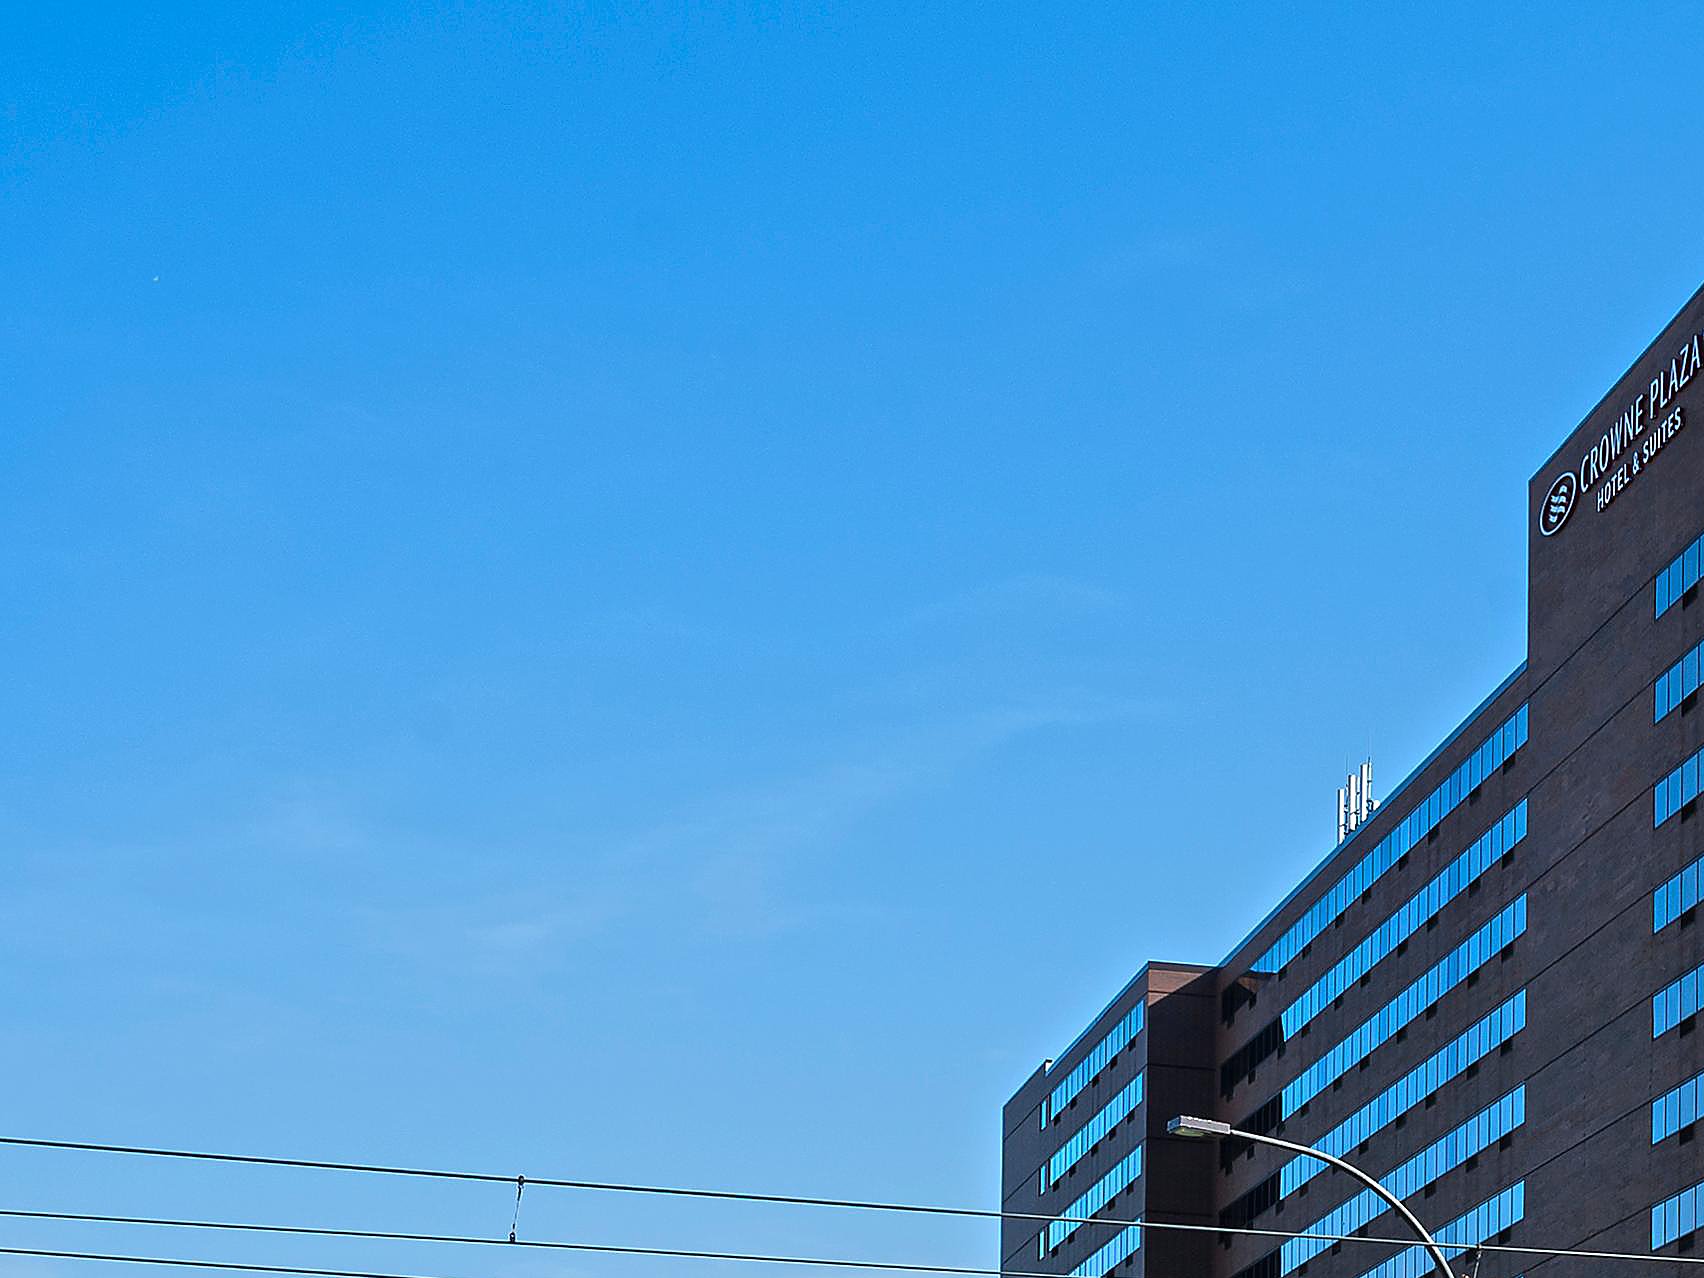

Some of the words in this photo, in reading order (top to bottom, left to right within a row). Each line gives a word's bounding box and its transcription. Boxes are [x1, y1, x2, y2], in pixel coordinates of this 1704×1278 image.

[1580, 394, 1644, 493] CROWNE
[1650, 334, 1701, 419] PLAZA
[1597, 463, 1630, 513] HOTEL
[1632, 452, 1640, 474] &
[1643, 407, 1682, 464] SUITES
